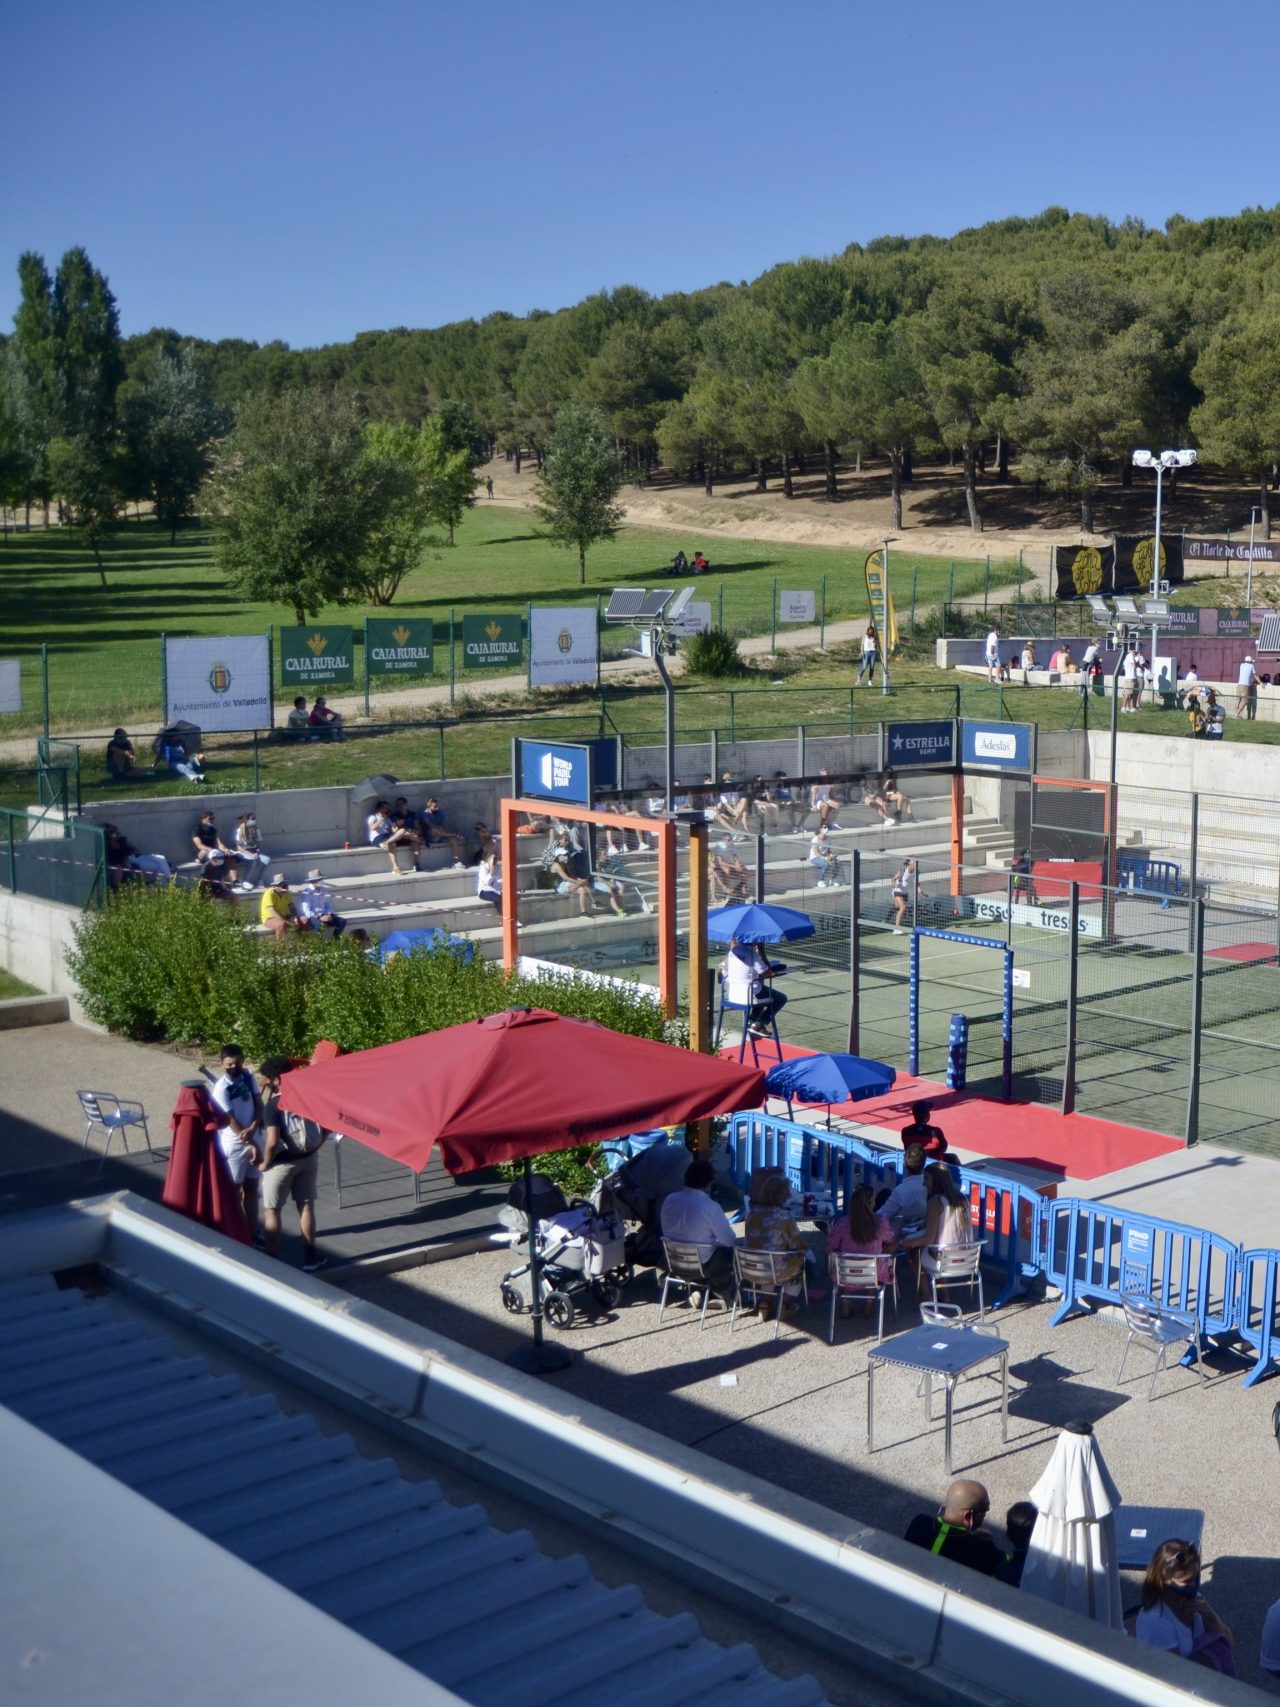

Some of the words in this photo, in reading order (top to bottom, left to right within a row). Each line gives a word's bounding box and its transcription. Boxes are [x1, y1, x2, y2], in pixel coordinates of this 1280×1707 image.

[1189, 542, 1200, 556] El
[1202, 542, 1223, 557] Norte
[1224, 545, 1235, 557] de
[1236, 545, 1273, 560] Castilla
[371, 648, 396, 661] CAJA
[396, 647, 430, 660] RURAL
[467, 643, 489, 655] CAJA
[489, 642, 520, 654] RURAL
[286, 658, 312, 671] CAJA
[312, 656, 349, 670] RURAL
[394, 661, 417, 669] ZAMORA
[572, 656, 596, 666] Valladolid
[309, 671, 336, 680] ZAMORA
[173, 701, 221, 713] Ayuntamiento
[222, 700, 231, 709] de
[233, 697, 268, 708] Valladolid
[906, 736, 950, 749] ESTRELLA
[982, 738, 1010, 752] Adeslas
[553, 756, 573, 770] WORLD
[553, 767, 572, 779] PADEL
[553, 777, 570, 787] TOUR
[1041, 910, 1086, 932] tress
